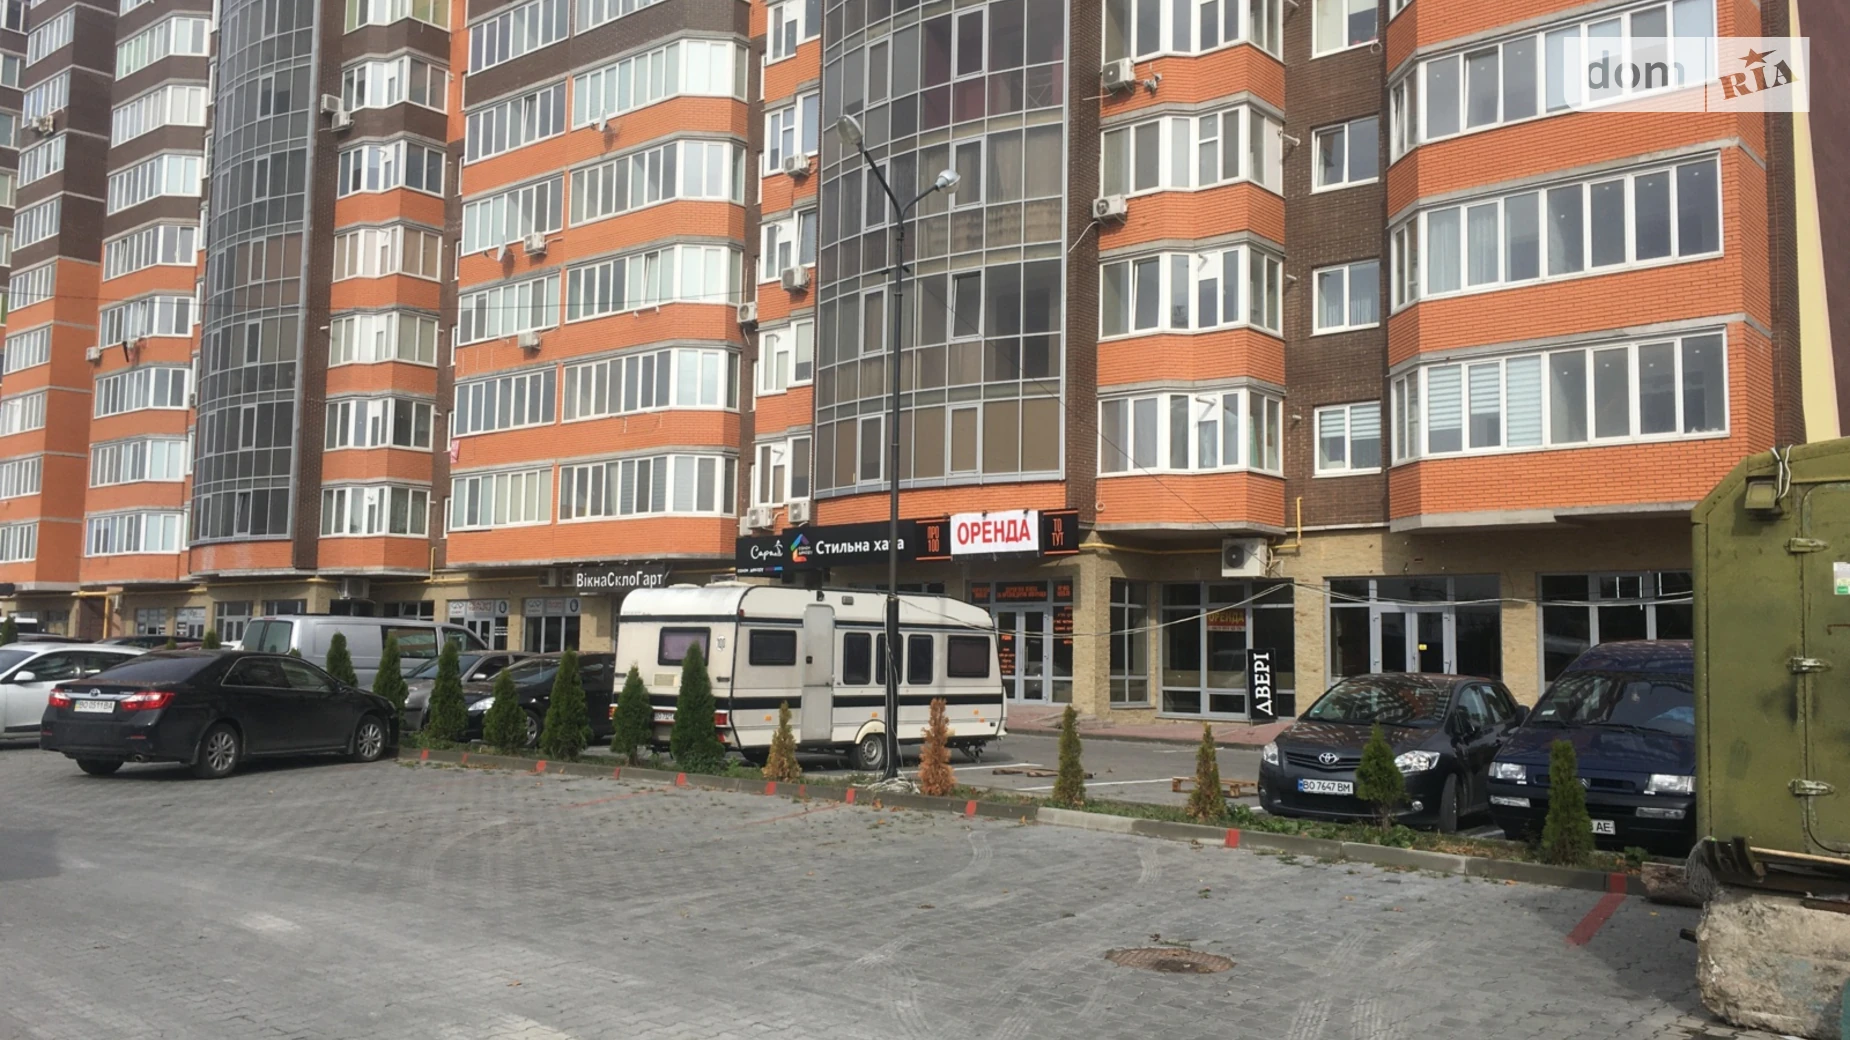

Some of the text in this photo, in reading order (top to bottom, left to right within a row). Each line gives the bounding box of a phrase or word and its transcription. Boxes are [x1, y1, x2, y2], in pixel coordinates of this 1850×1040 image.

[957, 519, 1031, 545] ОРЕНДА
[1053, 518, 1062, 532] ТО
[815, 540, 870, 555] Стильна
[873, 539, 904, 551] хаа
[1051, 532, 1064, 546] ТУТ
[576, 571, 663, 588] ВікнаСклоГарт
[1253, 652, 1273, 716] ДВЕРІ
